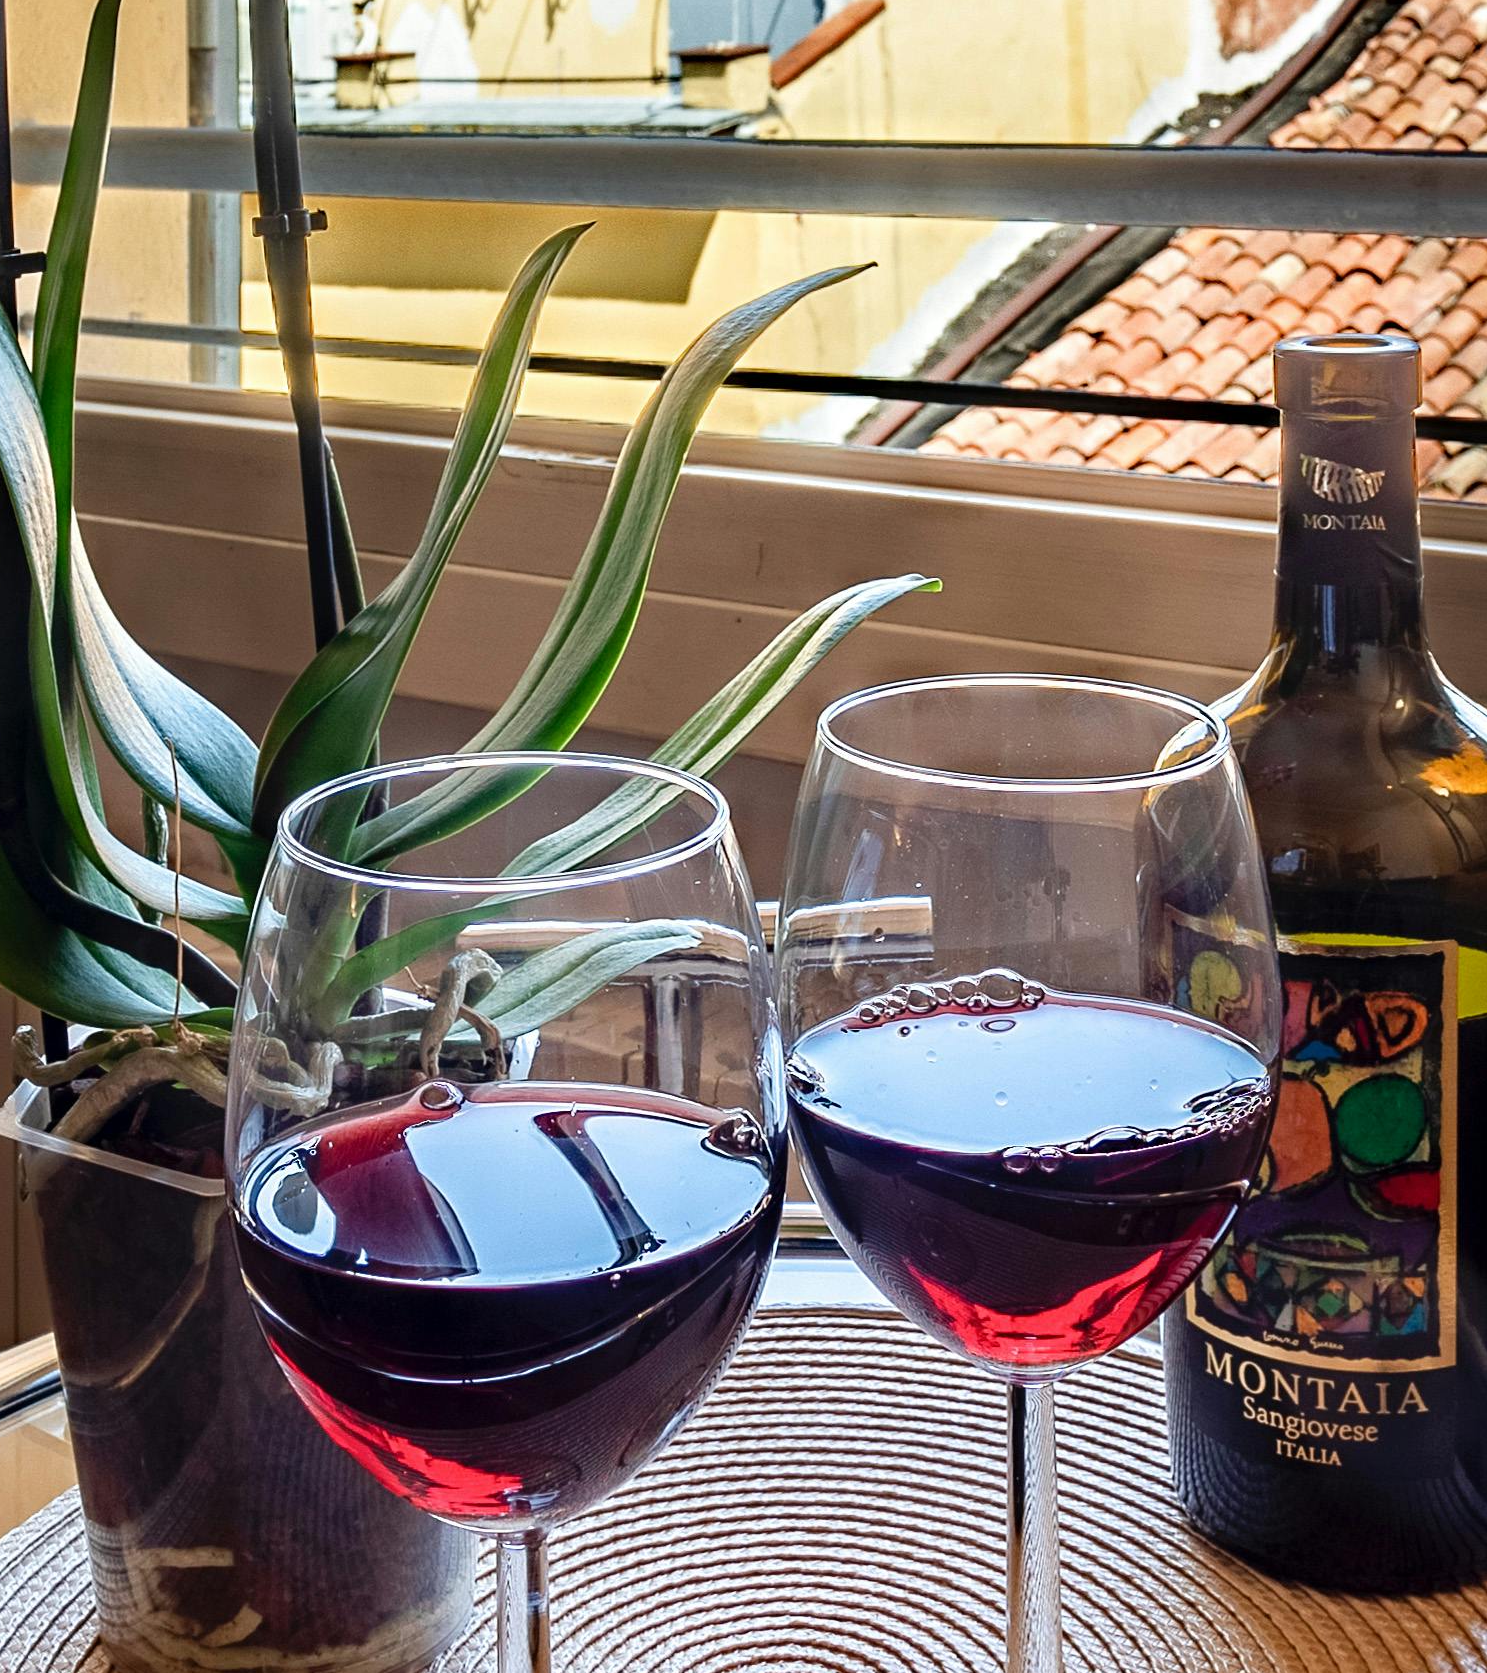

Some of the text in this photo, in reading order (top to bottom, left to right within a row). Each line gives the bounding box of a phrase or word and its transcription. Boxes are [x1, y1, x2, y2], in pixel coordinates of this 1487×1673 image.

[1302, 513, 1386, 531] MONTAIA
[1205, 1341, 1430, 1415] MONTAIA
[1242, 1395, 1379, 1443] Sangiovese
[1275, 1439, 1343, 1467] ITALIA
